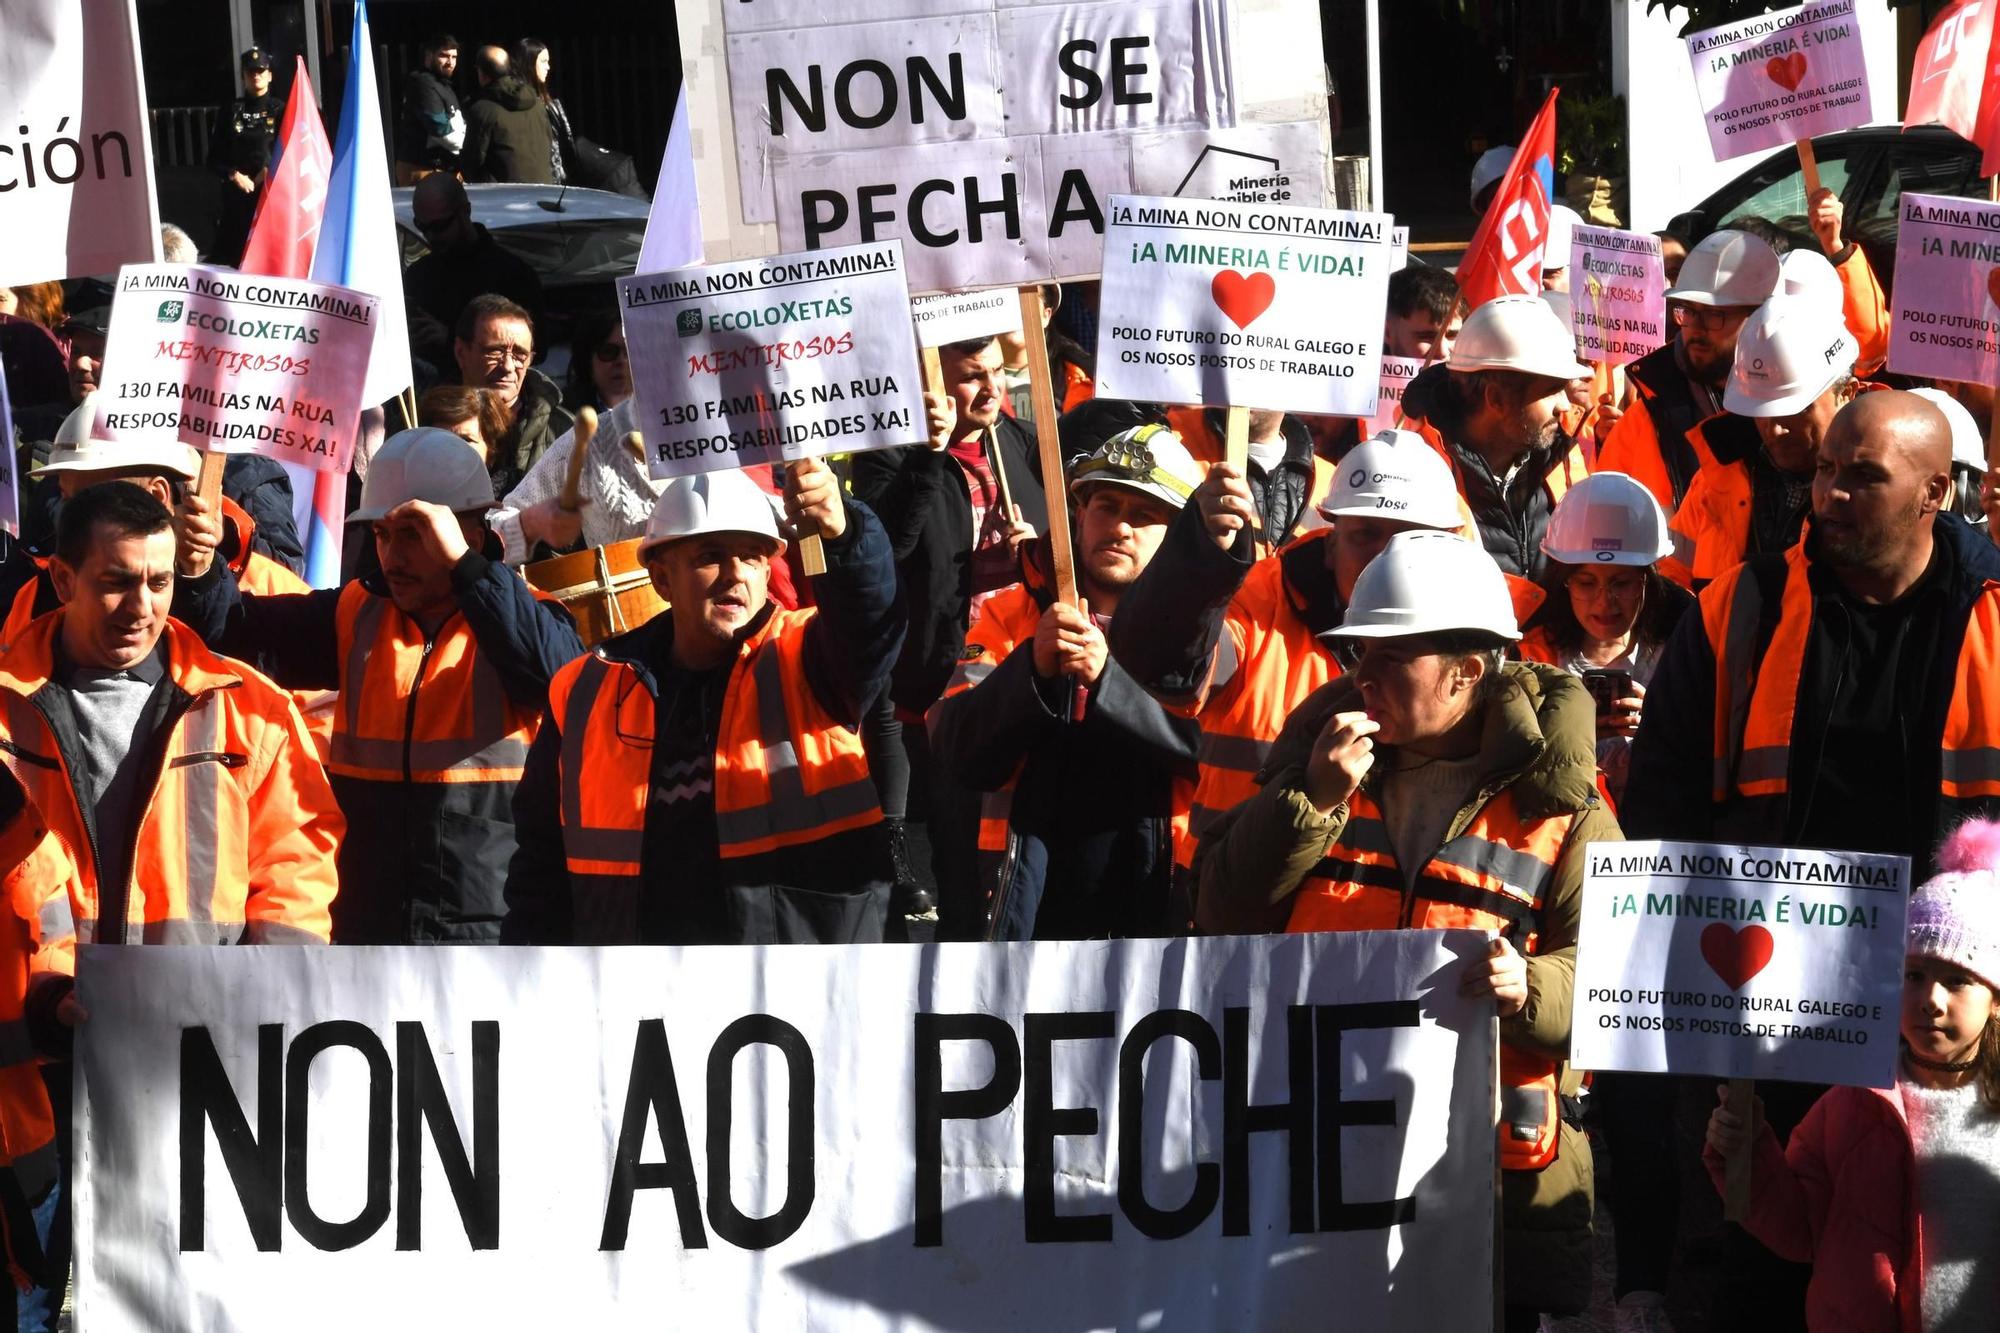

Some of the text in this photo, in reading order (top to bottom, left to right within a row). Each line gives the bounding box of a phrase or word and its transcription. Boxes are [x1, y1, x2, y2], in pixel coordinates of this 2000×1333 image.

[1708, 31, 1742, 48] MINA
[1745, 21, 1774, 38] NON
[1777, 2, 1852, 29] CONTAMINA!
[1732, 38, 1799, 67] MINERIA
[1803, 31, 1811, 48] É
[1813, 24, 1851, 44] VIDA!
[765, 36, 1153, 136] NON SE
[1714, 108, 1739, 123] POLO
[1741, 99, 1779, 116] FUTURO
[1781, 95, 1795, 105] DO
[1798, 87, 1827, 102] RURAL
[1829, 79, 1857, 94] GALEGO
[1724, 93, 1861, 135] OS NOSOS POSTOS DE TRABALLO
[1229, 174, 1290, 190] Minería
[1271, 189, 1291, 201] de
[1138, 207, 1190, 226] MINA
[1196, 209, 1241, 229] NON
[1248, 213, 1382, 240] CONTAMINA!
[1928, 207, 1971, 225] MINA
[1594, 234, 1611, 248] NON
[651, 280, 702, 301] MINA
[707, 270, 754, 293] NON
[759, 249, 895, 286] CONTAMINA!
[1165, 243, 1270, 269] MINERIA
[1277, 246, 1290, 271] É
[1297, 251, 1365, 277] VIDA!
[145, 275, 190, 291] MINA
[196, 278, 239, 299] NON
[245, 285, 370, 322] CONTAMINA!
[709, 297, 853, 333] ECOLOXETAS
[952, 297, 1004, 314] TRABALLO
[186, 310, 320, 344] ECOLOXETAS
[1624, 319, 1640, 333] NA
[1641, 322, 1658, 337] RUA
[1902, 310, 1936, 325] POLO
[1940, 315, 1989, 331] FUTURO
[687, 332, 854, 378] MENTIROSOS
[1112, 326, 1367, 356] POLO FUTURO DO RURAL GALEGO E
[1909, 331, 1926, 343] OS
[1930, 333, 1973, 349] NOSOS
[154, 340, 310, 376] MENTIROSOS
[1121, 350, 1355, 378] OS NOSOS POSTOS DE TRABALLO
[1382, 363, 1414, 376] NON
[118, 382, 335, 426] 130 FAMILIAS NA RUA
[660, 376, 898, 426] 130 FAMILIAS NA RUA
[106, 412, 337, 457] RESPOSABILIDADES XA!
[658, 408, 910, 462] RESPOSABILIDADES XA!
[1375, 496, 1408, 510] Jose
[1620, 855, 1673, 873] MINA
[1680, 855, 1733, 876] NON
[1741, 858, 1898, 888] CONTAMINA!
[1646, 893, 1767, 922] MINERIA
[1776, 896, 1789, 923] É
[1799, 902, 1879, 930] VIDA!
[1588, 988, 1881, 1020] POLO FUTURO DO RURAL GALEGO E
[1598, 1014, 1868, 1046] OS NOSOS POSTOS DE TRABALLO
[179, 1000, 1420, 1252] NON AO PECHE
